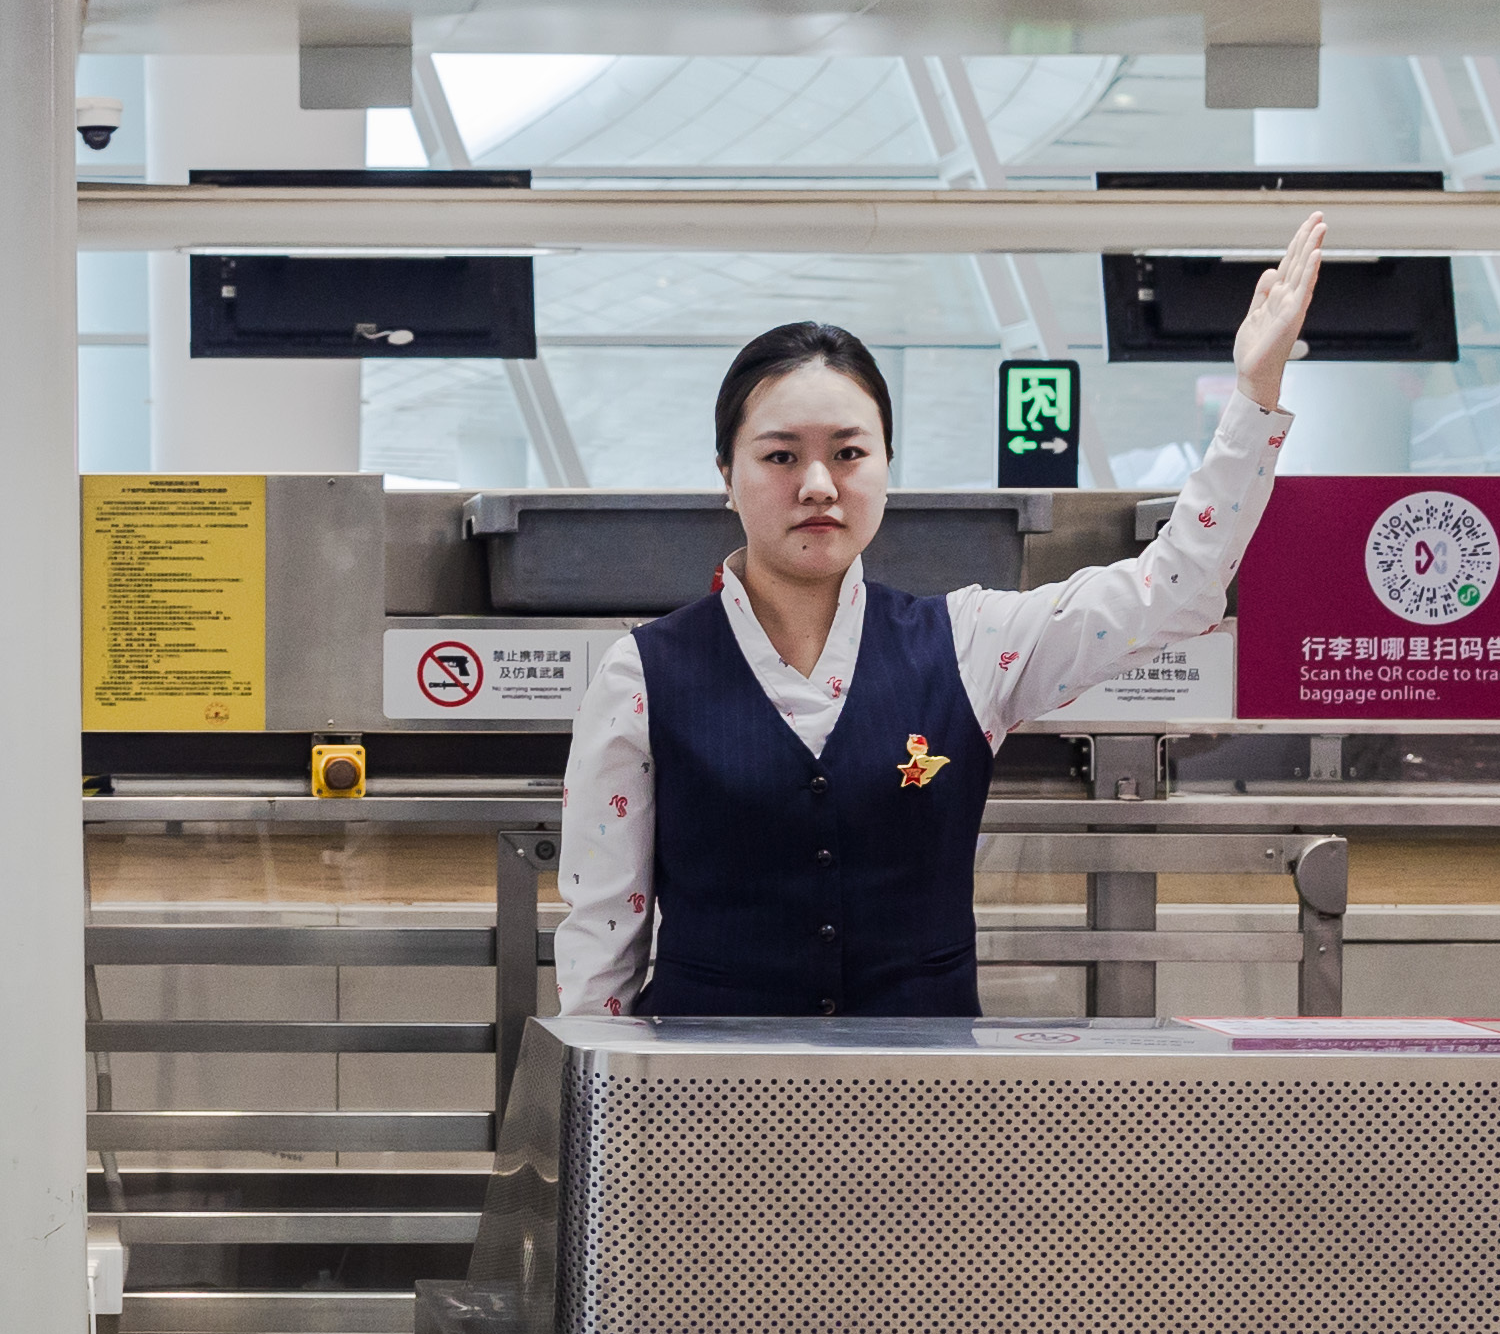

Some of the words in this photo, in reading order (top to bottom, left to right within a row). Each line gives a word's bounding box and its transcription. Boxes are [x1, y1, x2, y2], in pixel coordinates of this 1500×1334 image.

[1301, 666, 1340, 680] Scan
[1345, 666, 1373, 680] the
[1378, 666, 1402, 682] QR
[1407, 666, 1448, 681] code
[1453, 668, 1471, 681] to
[1300, 685, 1376, 703] baggage
[1381, 686, 1440, 700] online.
